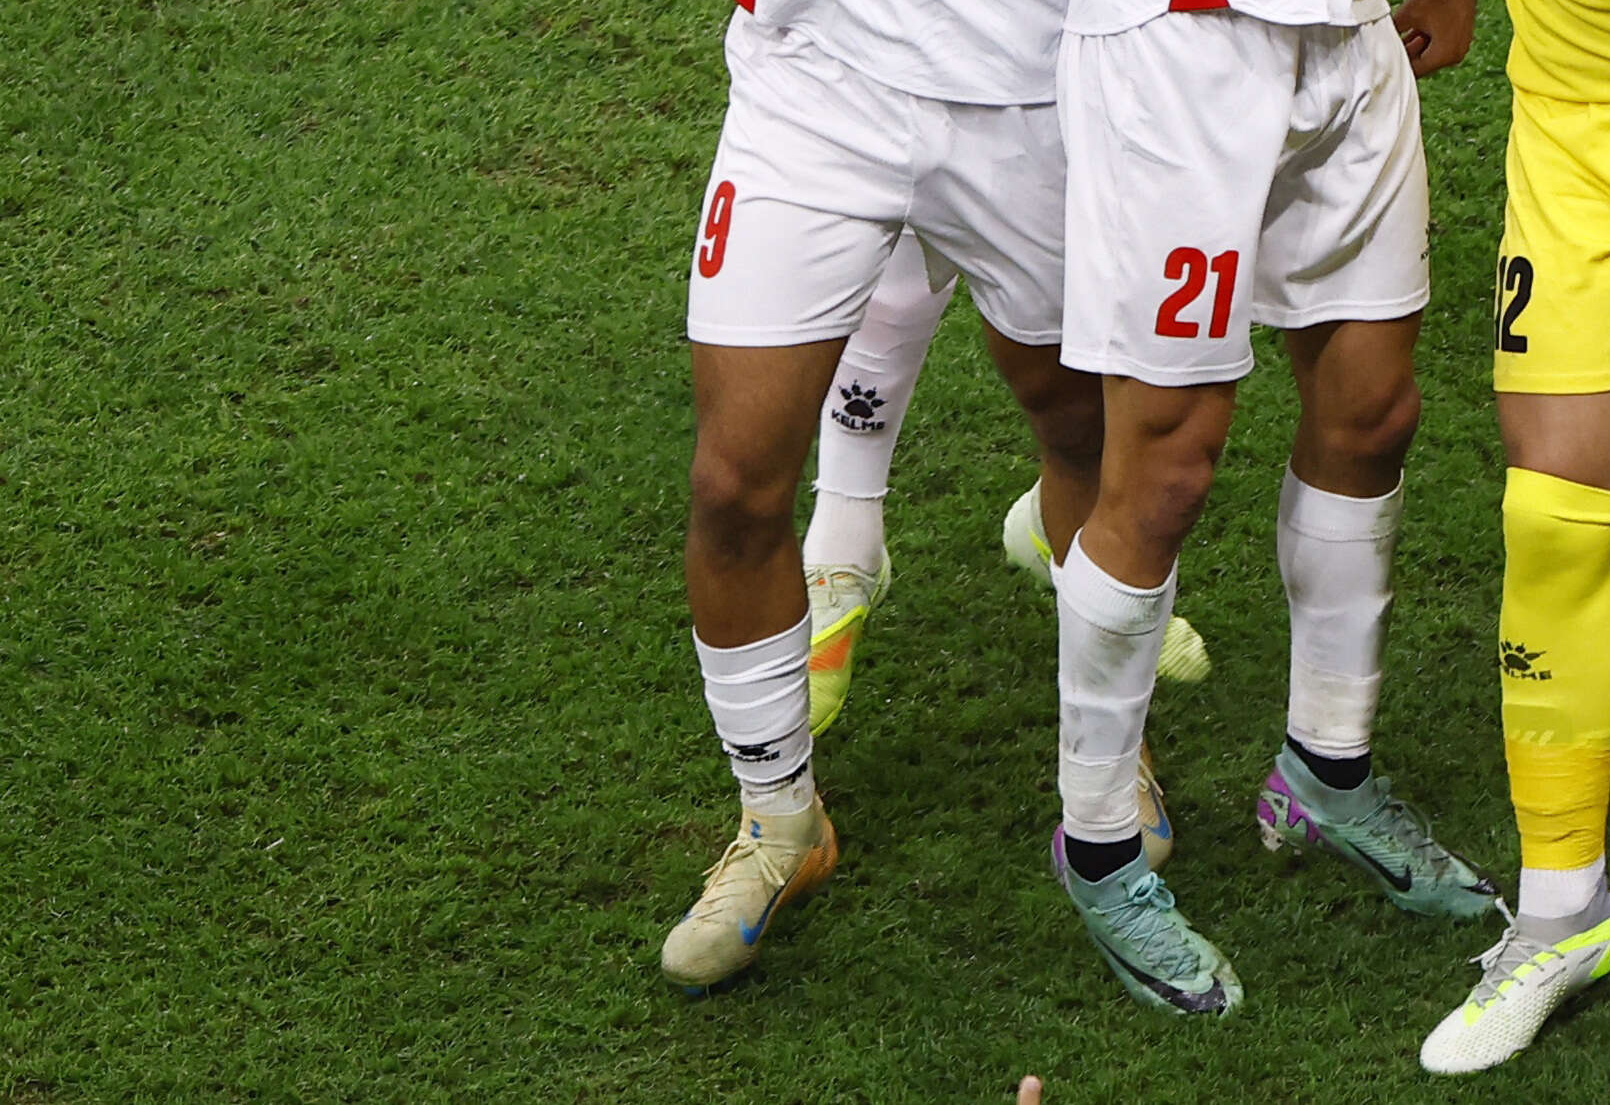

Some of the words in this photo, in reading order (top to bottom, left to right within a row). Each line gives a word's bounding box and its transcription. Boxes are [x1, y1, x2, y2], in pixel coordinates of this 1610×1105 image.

[698, 180, 736, 279] 9
[1154, 246, 1240, 338] 21
[831, 408, 886, 431] KELME
